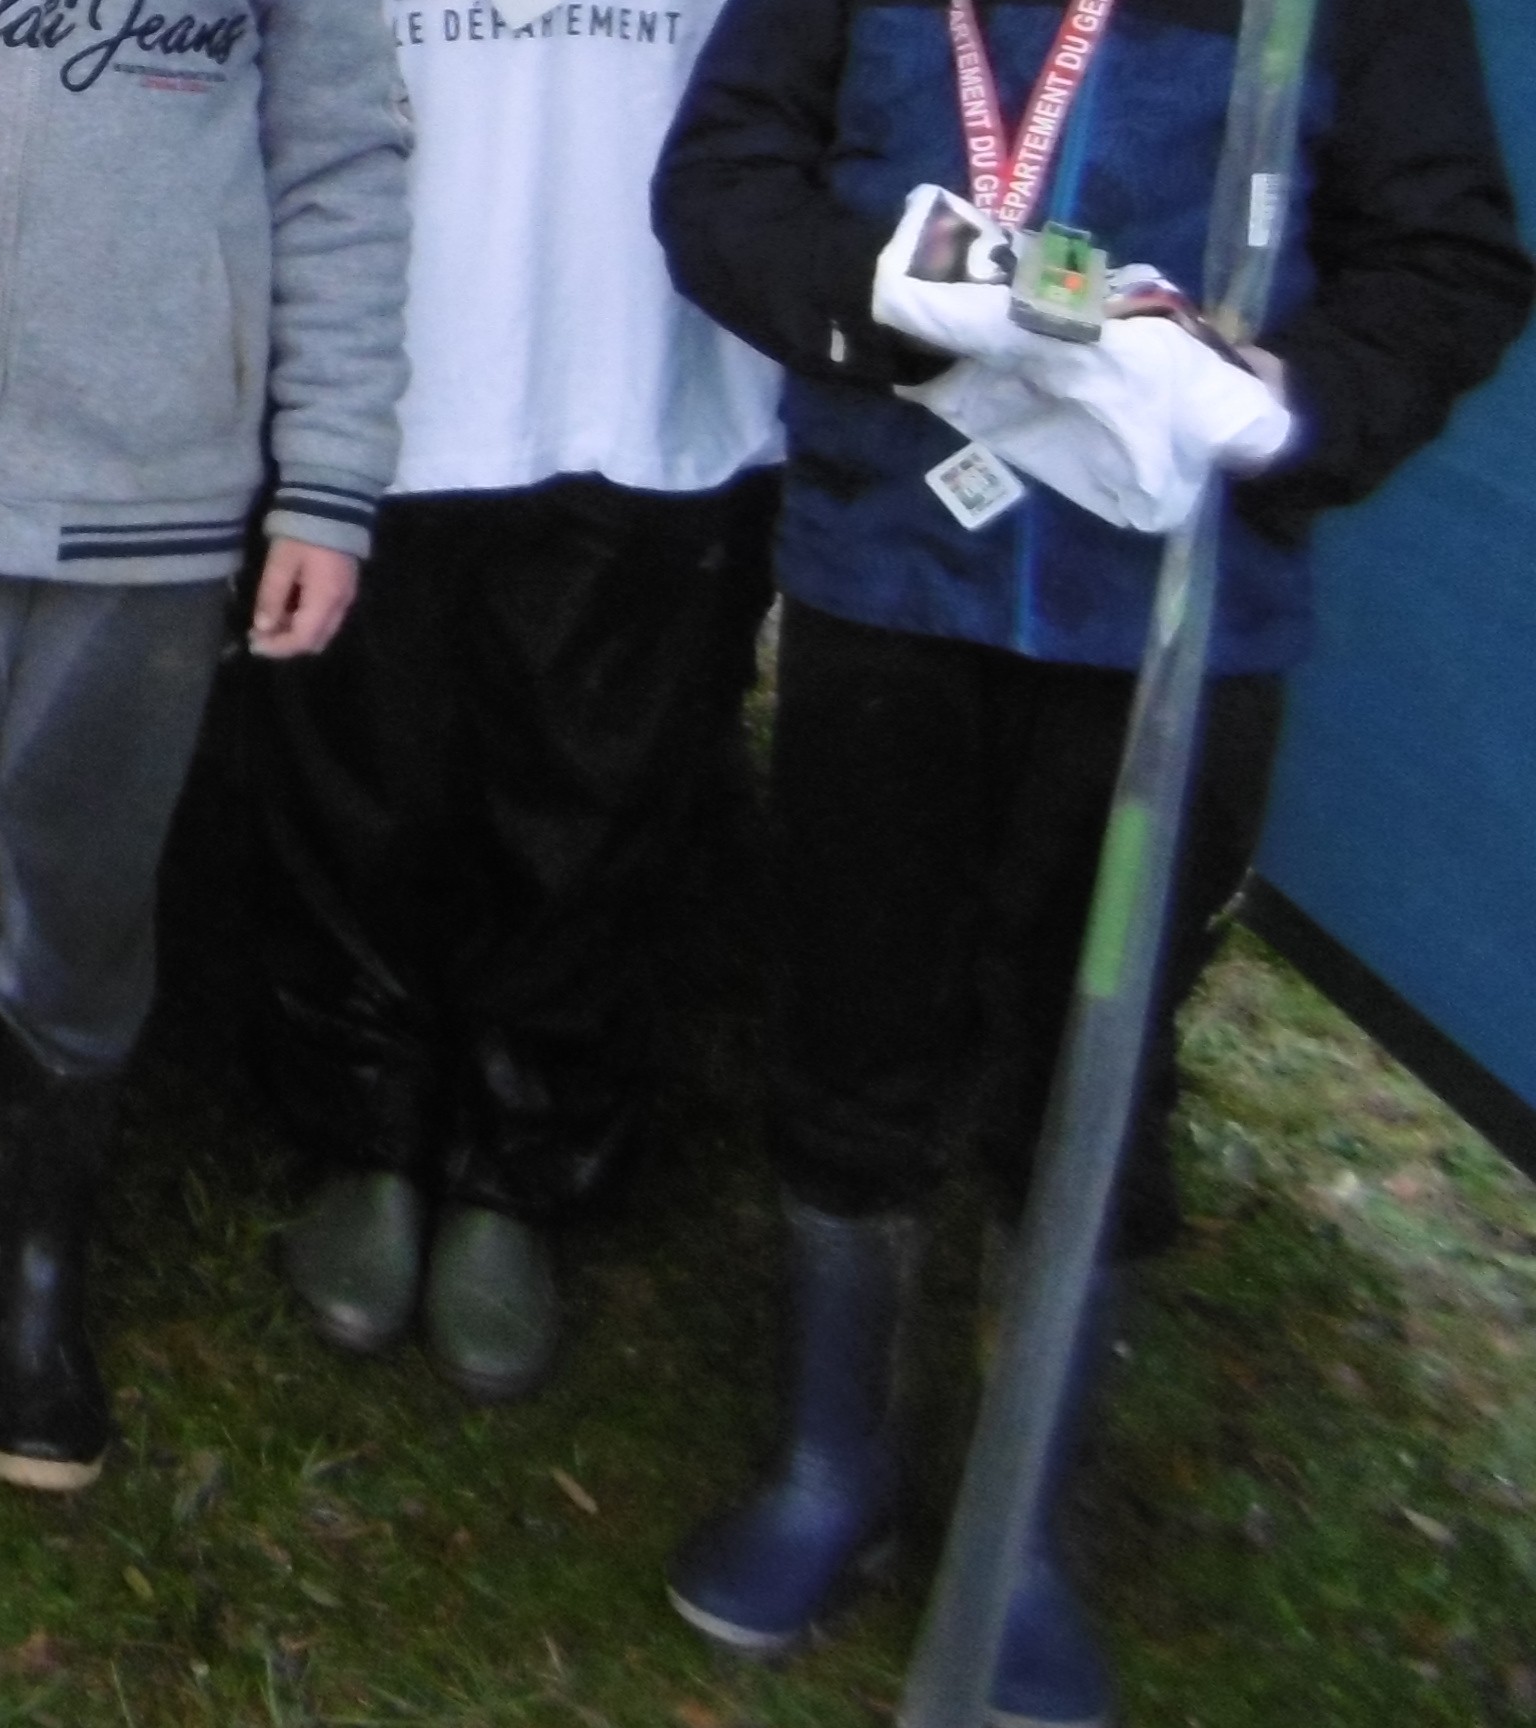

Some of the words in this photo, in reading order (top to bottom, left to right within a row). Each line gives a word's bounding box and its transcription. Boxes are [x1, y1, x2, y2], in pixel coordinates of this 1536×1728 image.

[443, 0, 682, 45] DÉPREMENT
[1054, 34, 1090, 71] DU
[968, 135, 998, 169] DU
